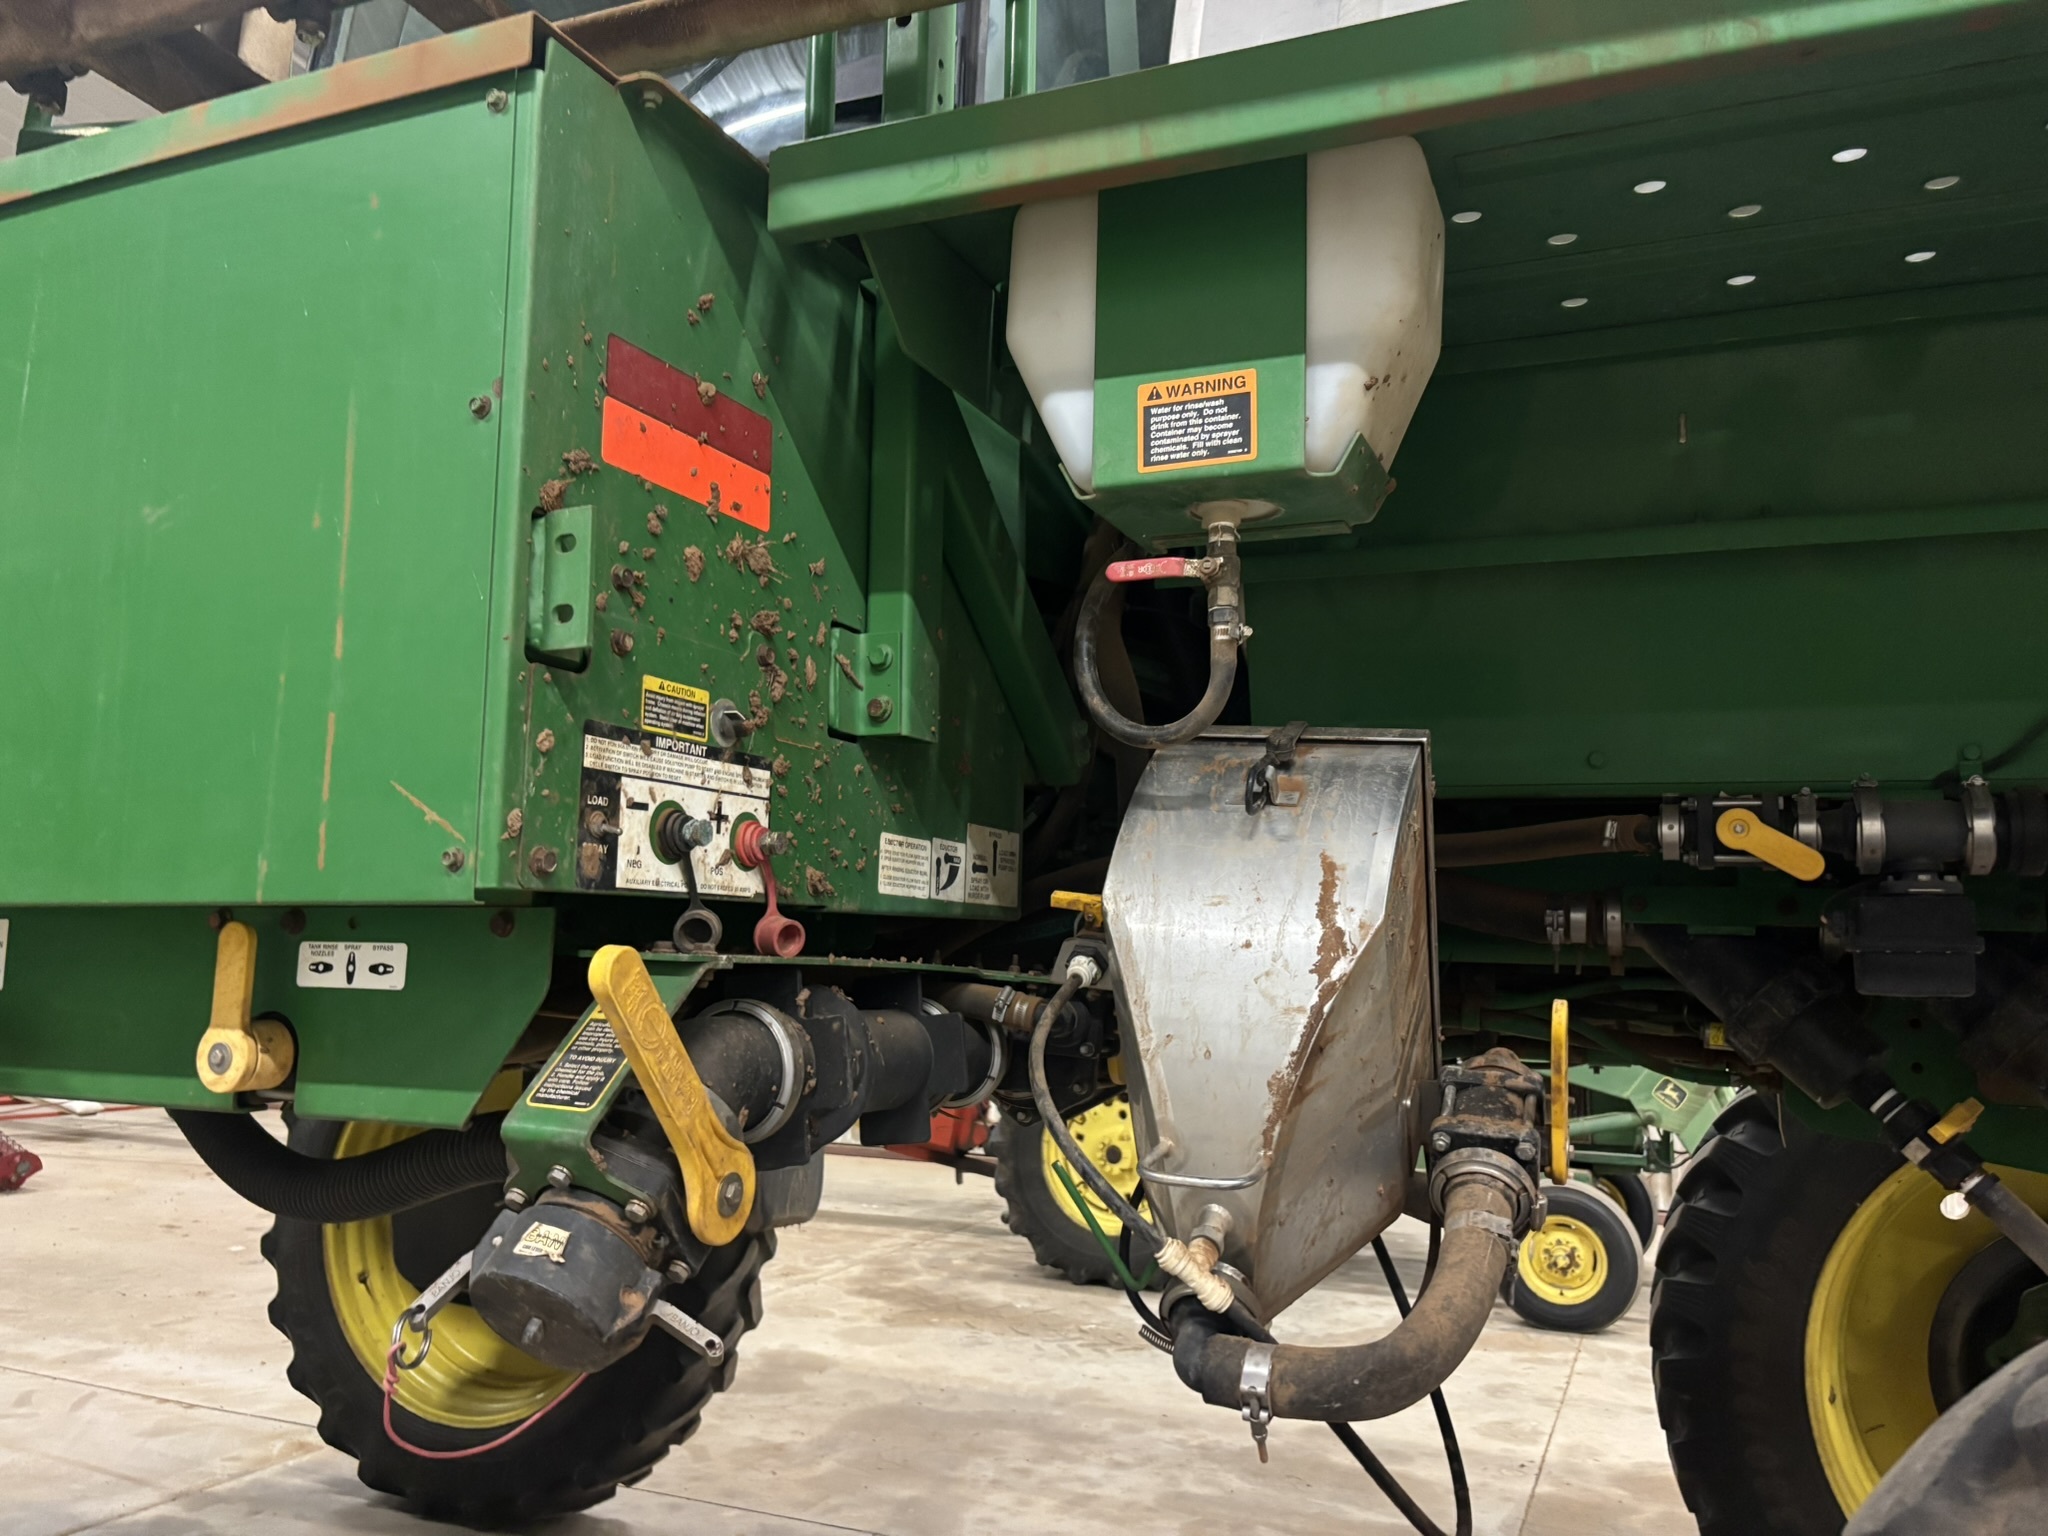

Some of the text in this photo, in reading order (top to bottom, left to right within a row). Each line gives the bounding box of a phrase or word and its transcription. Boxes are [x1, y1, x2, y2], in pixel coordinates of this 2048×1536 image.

[1166, 376, 1246, 398] WARNING
[1151, 406, 1170, 415] Water
[1185, 398, 1224, 410] rinse/wash
[1151, 414, 1180, 424] purpose
[1182, 412, 1200, 420] only.
[1151, 422, 1169, 430] drink
[1189, 417, 1202, 425] this
[1204, 414, 1241, 424] container.
[1151, 428, 1186, 438] Container
[1204, 422, 1234, 432] become
[1151, 430, 1240, 446] contaminated by sprayer
[1151, 444, 1188, 454] chemicals.
[1206, 439, 1220, 448] with
[1222, 437, 1242, 446] clean
[1151, 449, 1210, 462] rinse water only.
[666, 684, 696, 698] CAUTION
[656, 736, 708, 757] IMPORTANT
[587, 795, 608, 806] LOAD
[940, 843, 958, 853] EDUCTOR
[626, 859, 642, 868] NEG
[710, 866, 724, 876] POS
[431, 1268, 461, 1298] BANJO
[671, 1313, 700, 1336] BANJO
